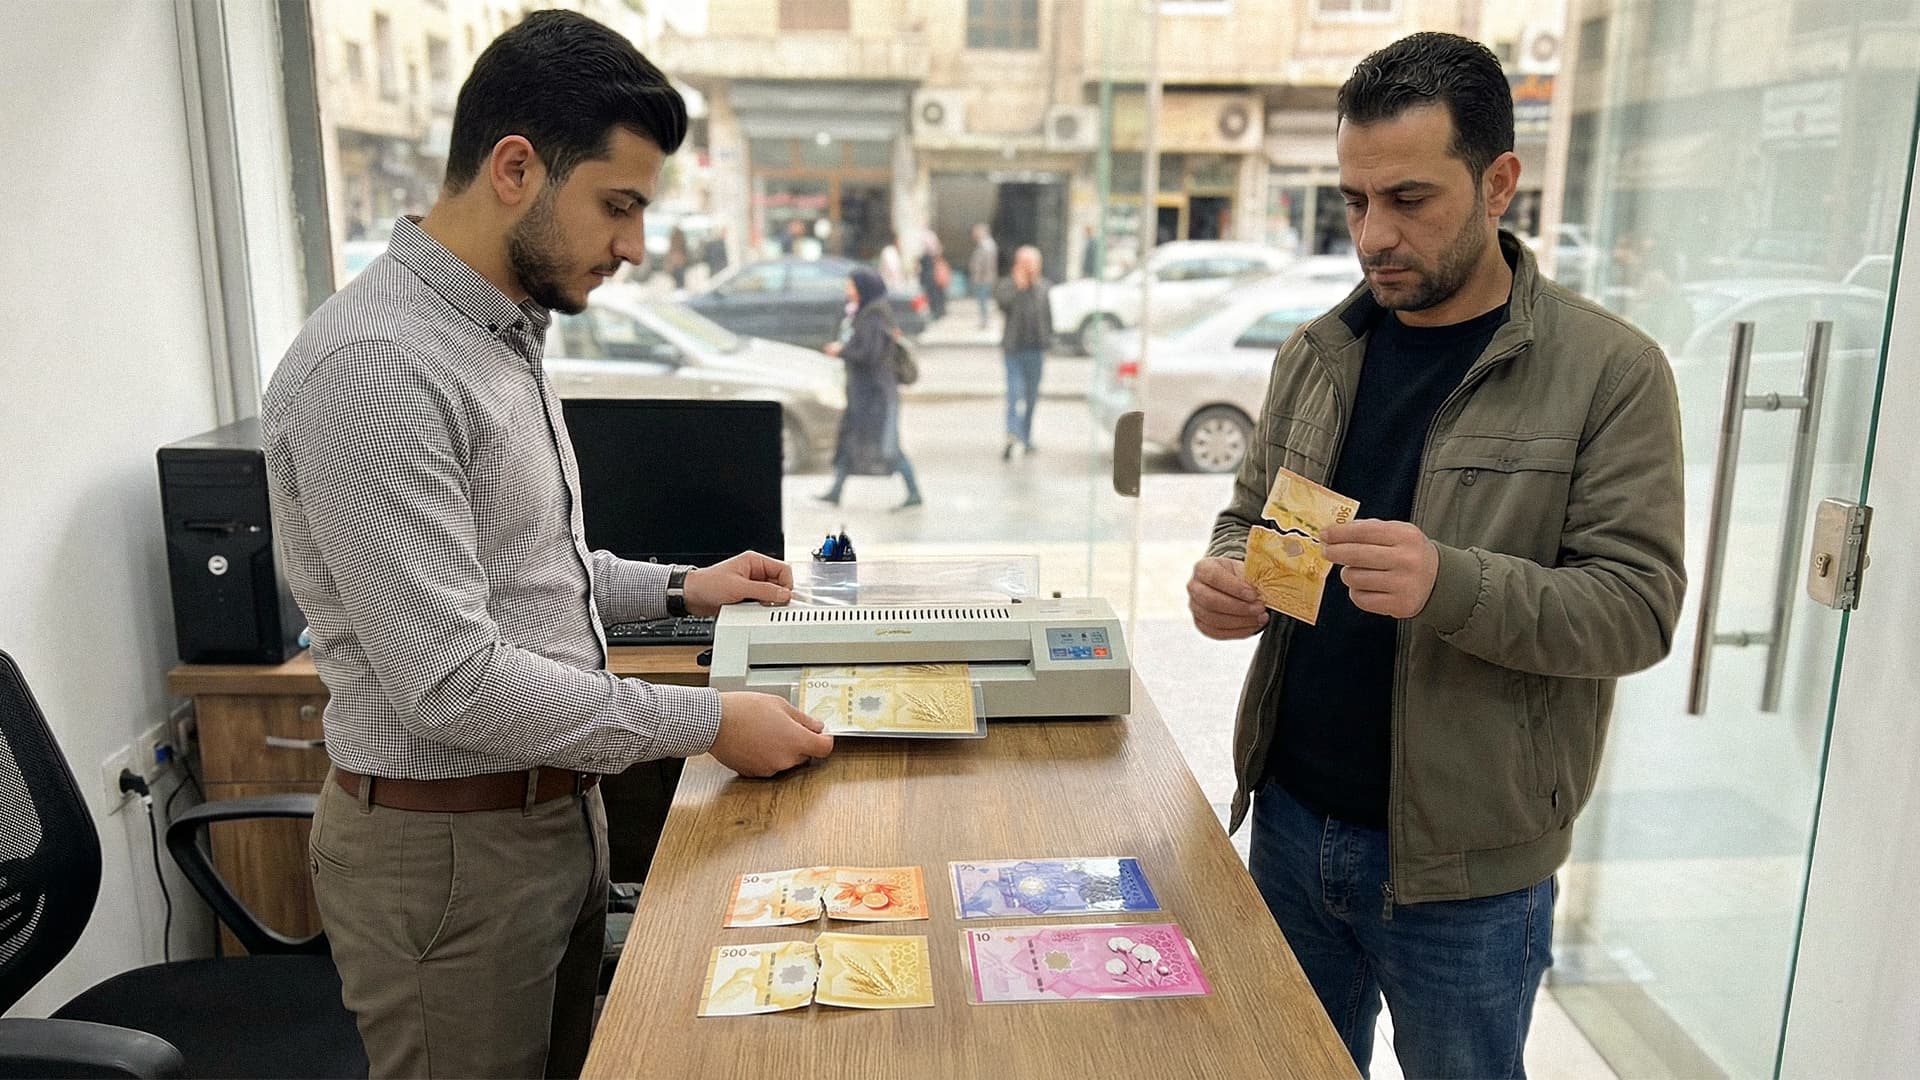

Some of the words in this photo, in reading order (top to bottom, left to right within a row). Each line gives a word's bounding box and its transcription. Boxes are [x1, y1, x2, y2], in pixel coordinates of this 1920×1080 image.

[1336, 505, 1352, 525] 500
[742, 875, 760, 884] 50
[975, 932, 990, 942] 10
[720, 948, 747, 958] 500
